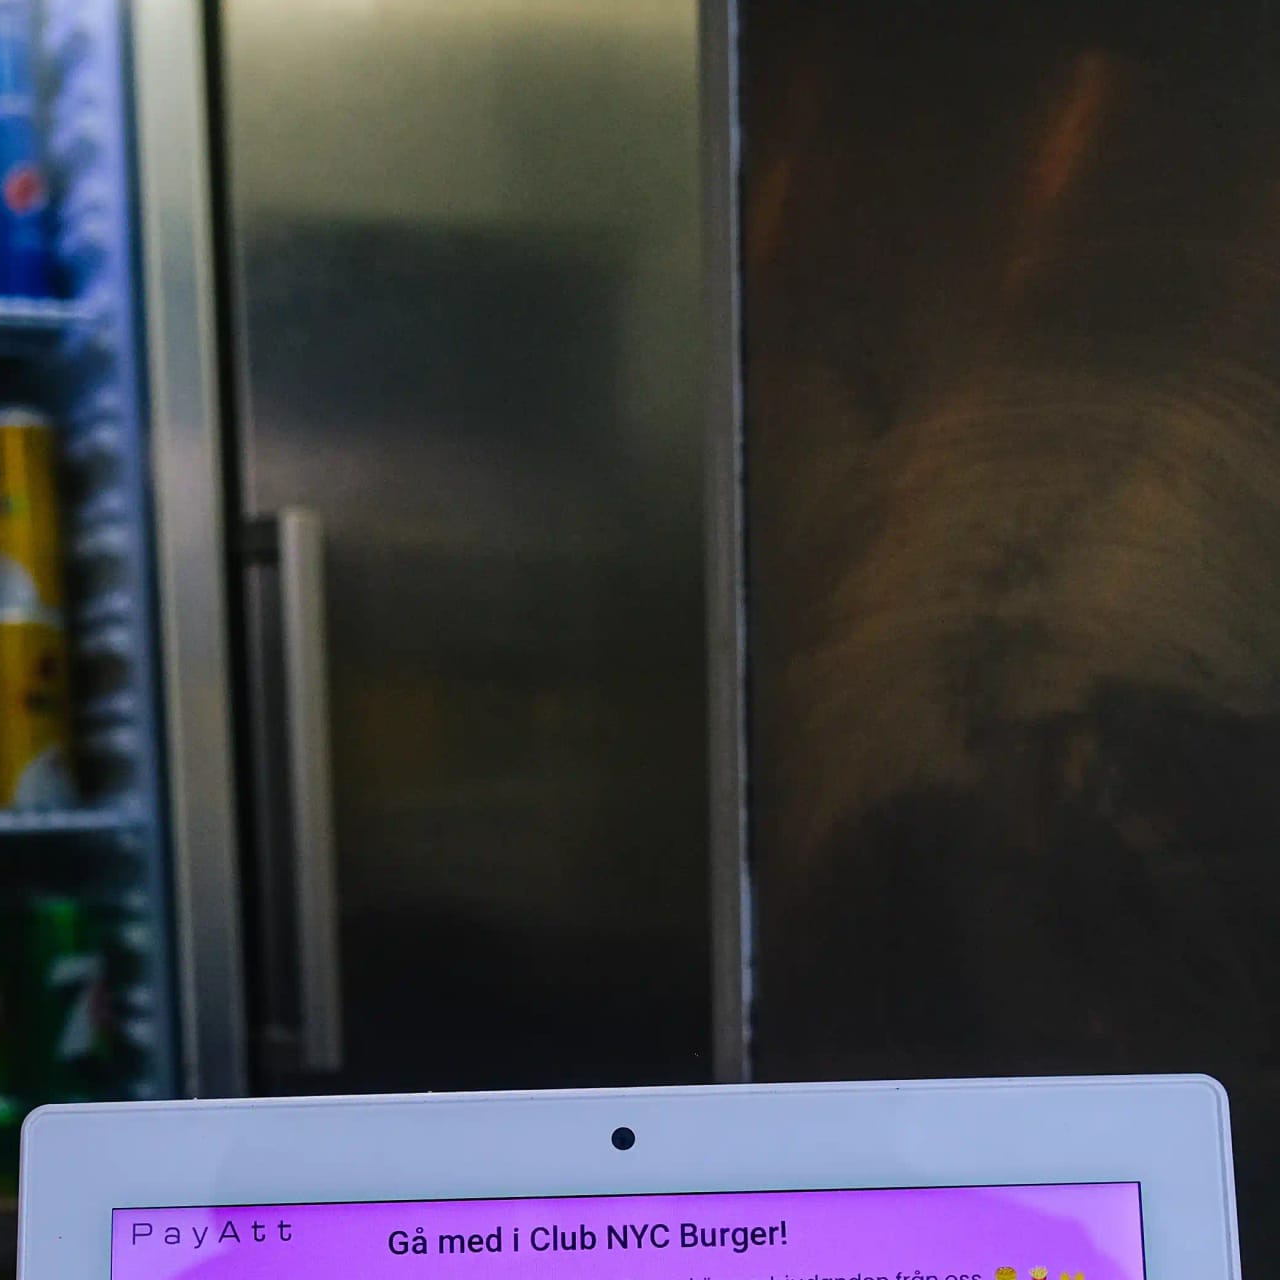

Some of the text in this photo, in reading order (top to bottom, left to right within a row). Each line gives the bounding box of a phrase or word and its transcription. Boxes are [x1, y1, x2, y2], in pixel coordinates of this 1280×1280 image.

[131, 1218, 293, 1249] PayAtt
[388, 1220, 787, 1256] Gå med i Club NYC Burger!
